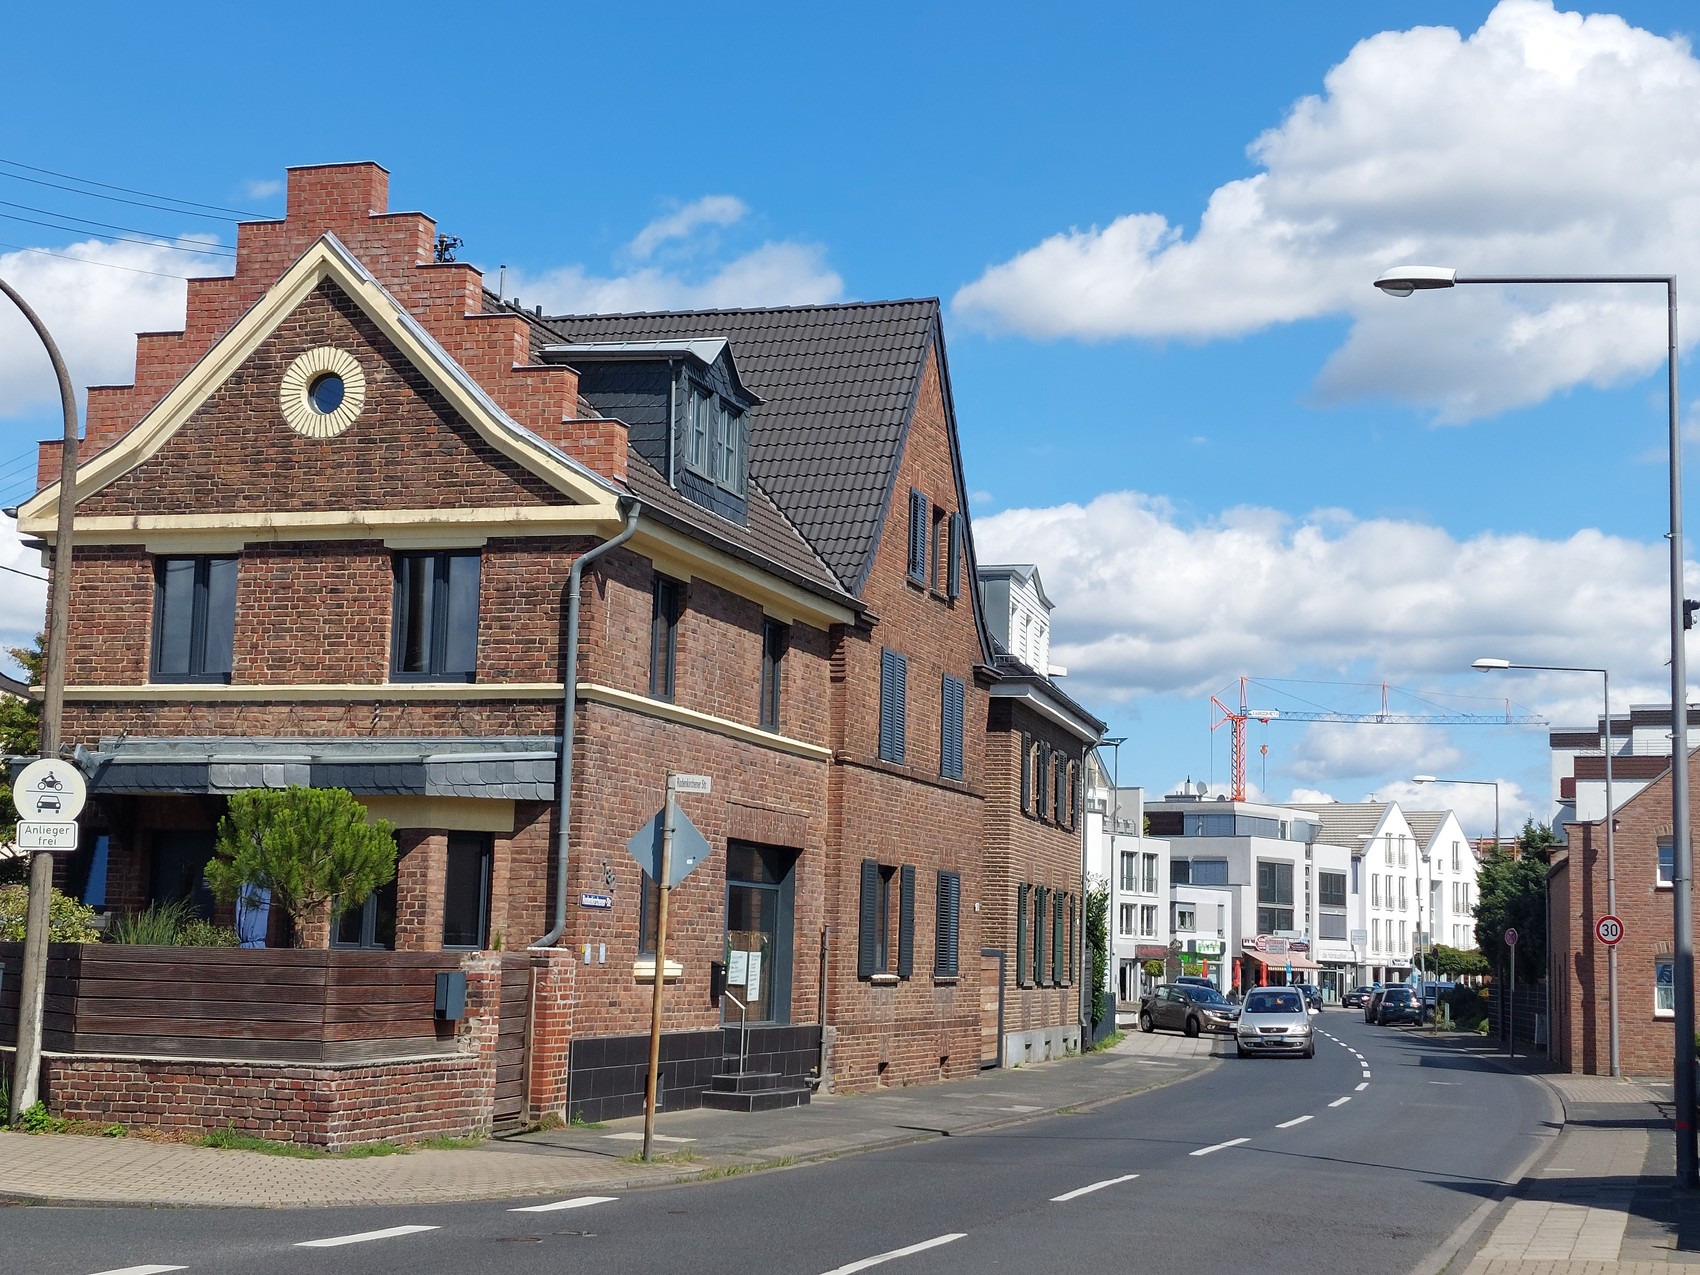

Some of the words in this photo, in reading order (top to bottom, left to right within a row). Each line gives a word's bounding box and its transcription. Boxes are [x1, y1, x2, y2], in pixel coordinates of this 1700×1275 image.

[25, 825, 70, 837] Anlieger
[38, 836, 57, 846] frei
[1602, 923, 1618, 937] 30
